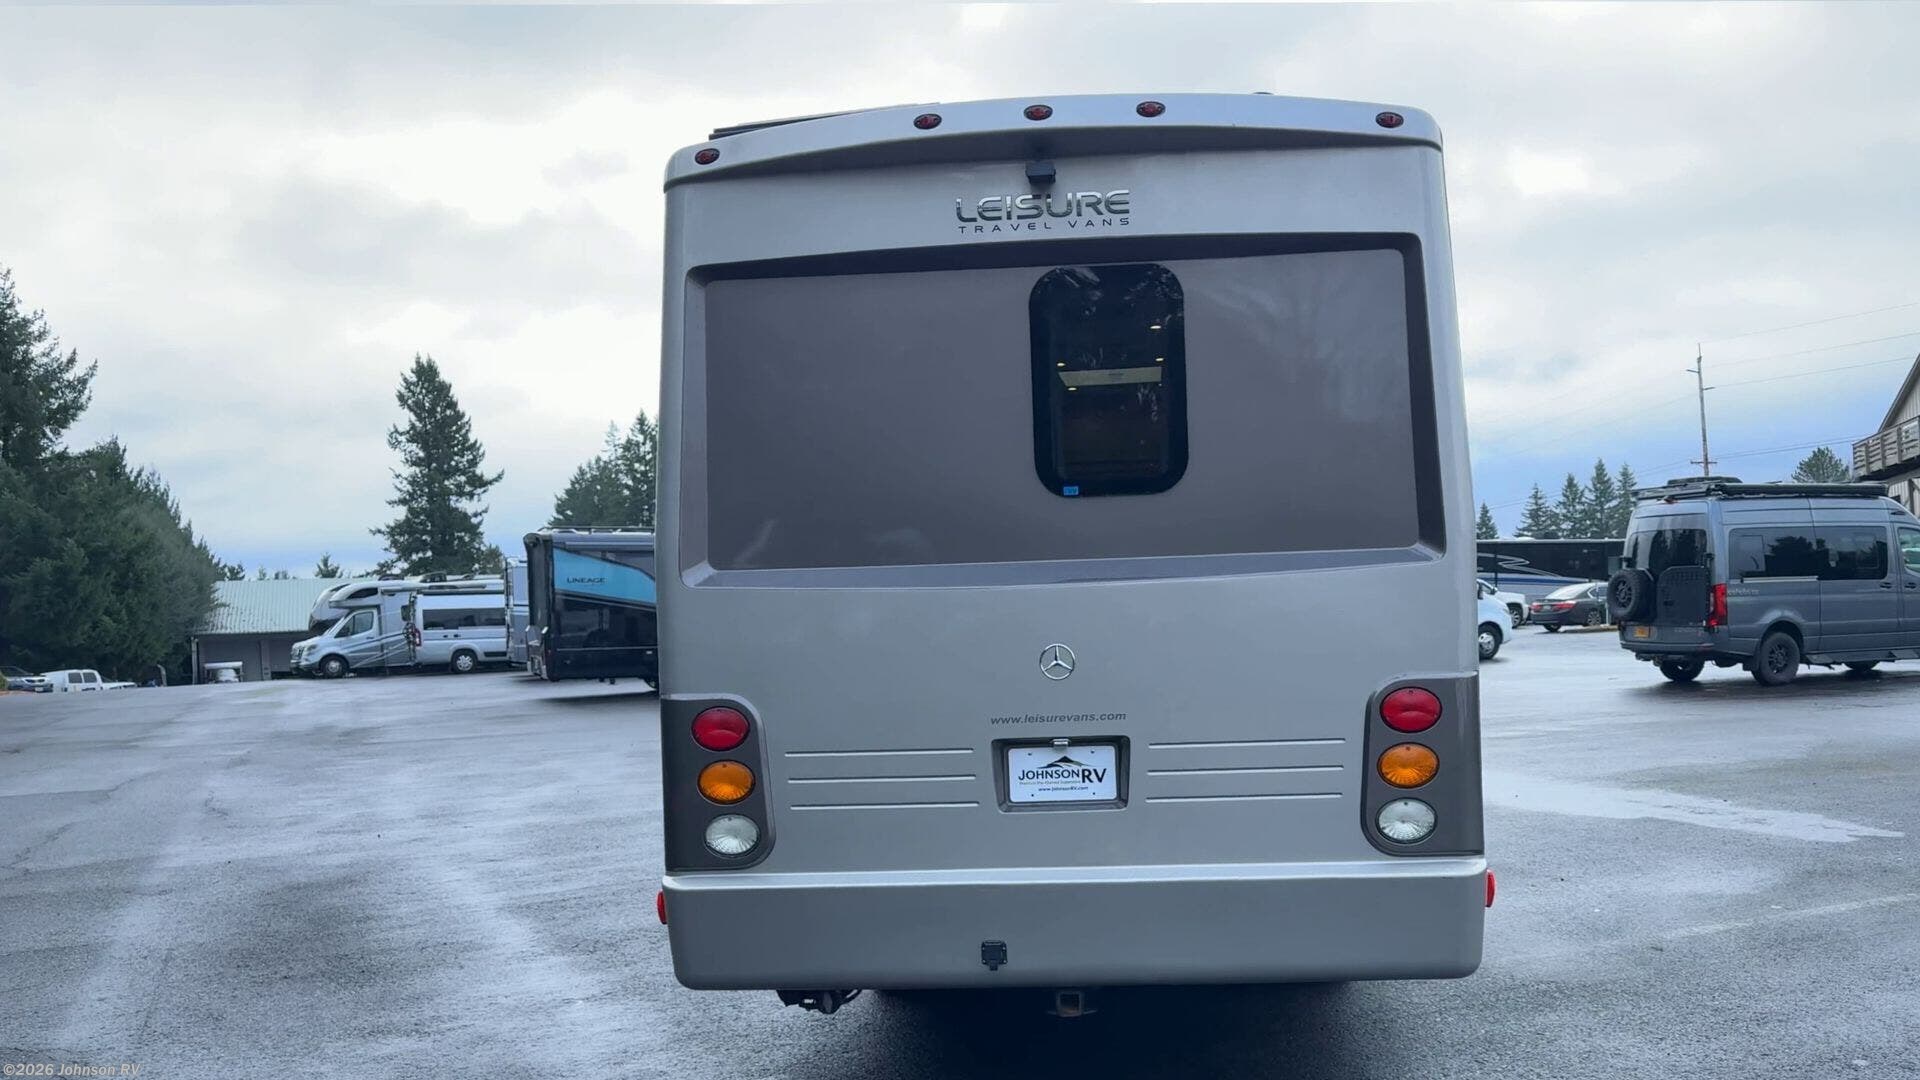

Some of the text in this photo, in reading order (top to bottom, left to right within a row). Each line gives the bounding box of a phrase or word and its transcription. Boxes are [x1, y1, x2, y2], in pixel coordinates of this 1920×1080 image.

[956, 190, 1130, 222] LEISURE
[959, 217, 1130, 234] TRAVEL VANS
[991, 712, 1126, 724] www.leisurevans.com
